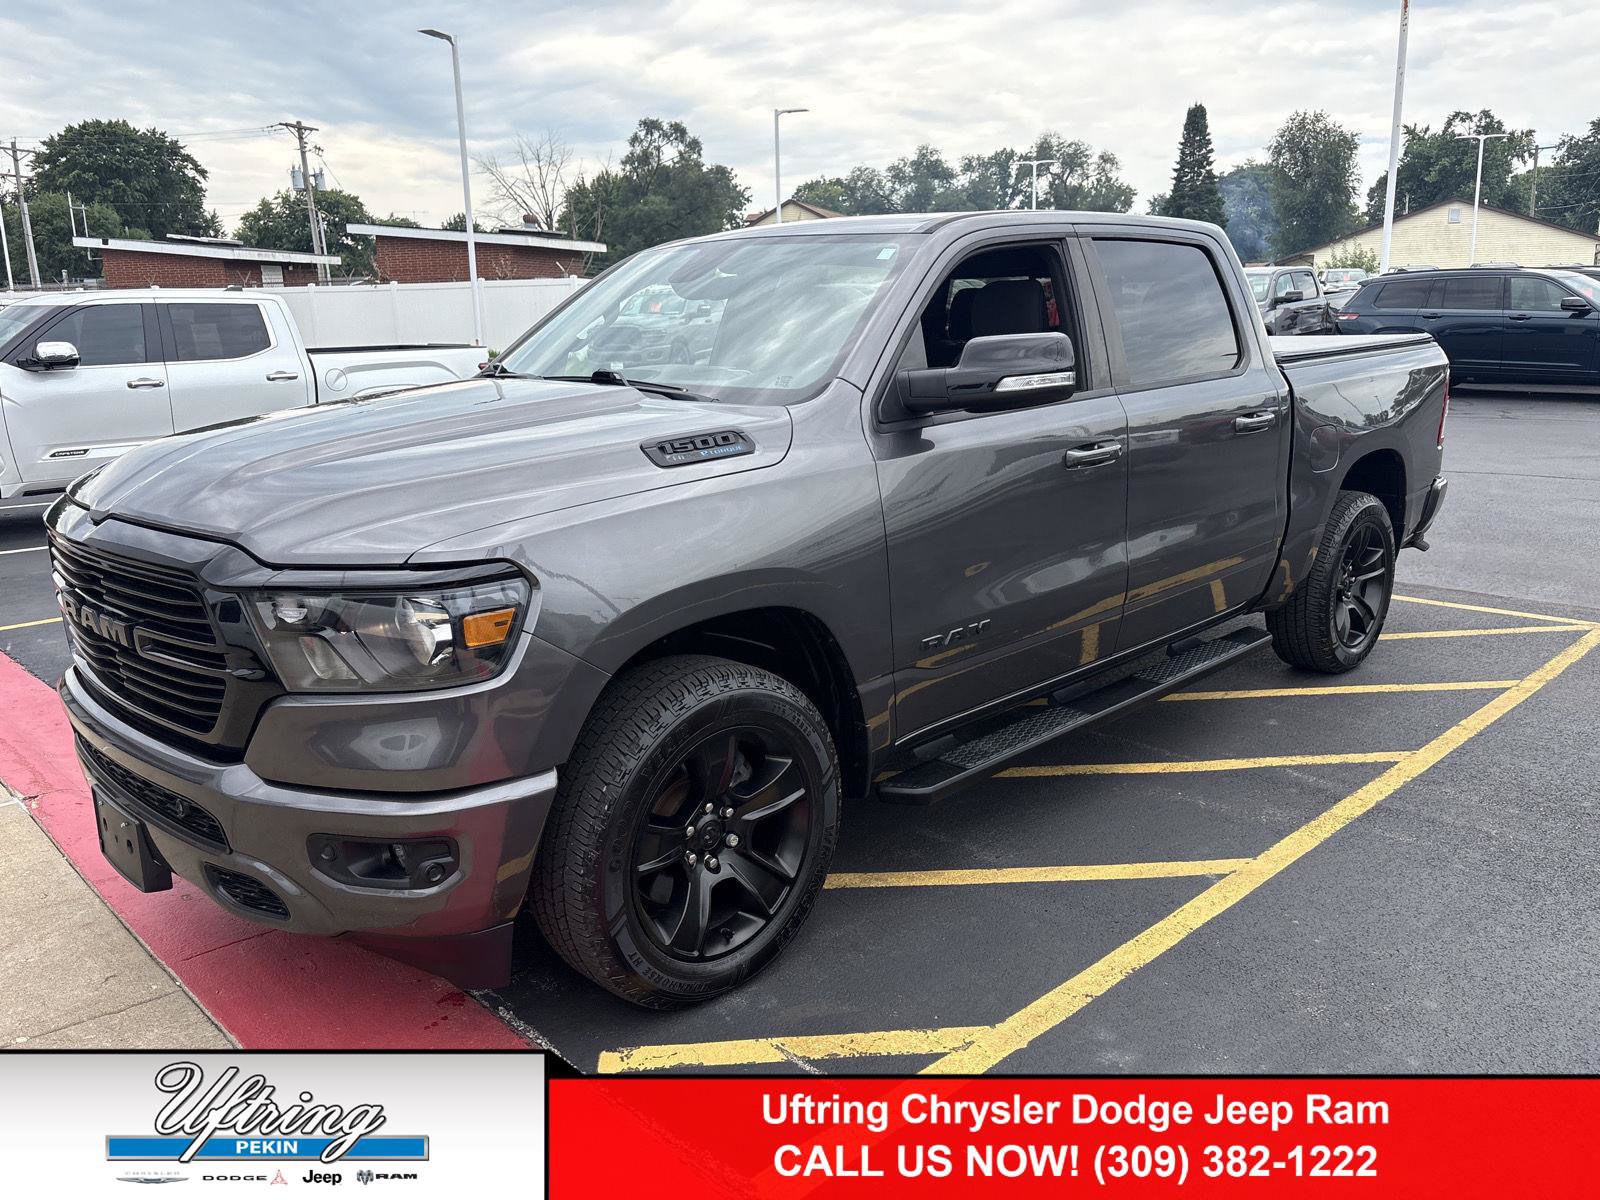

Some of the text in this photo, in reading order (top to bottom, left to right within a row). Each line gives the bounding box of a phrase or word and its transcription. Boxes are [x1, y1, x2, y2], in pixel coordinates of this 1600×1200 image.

[657, 434, 736, 455] 1500
[62, 591, 129, 648] RAM
[921, 618, 991, 650] RAM
